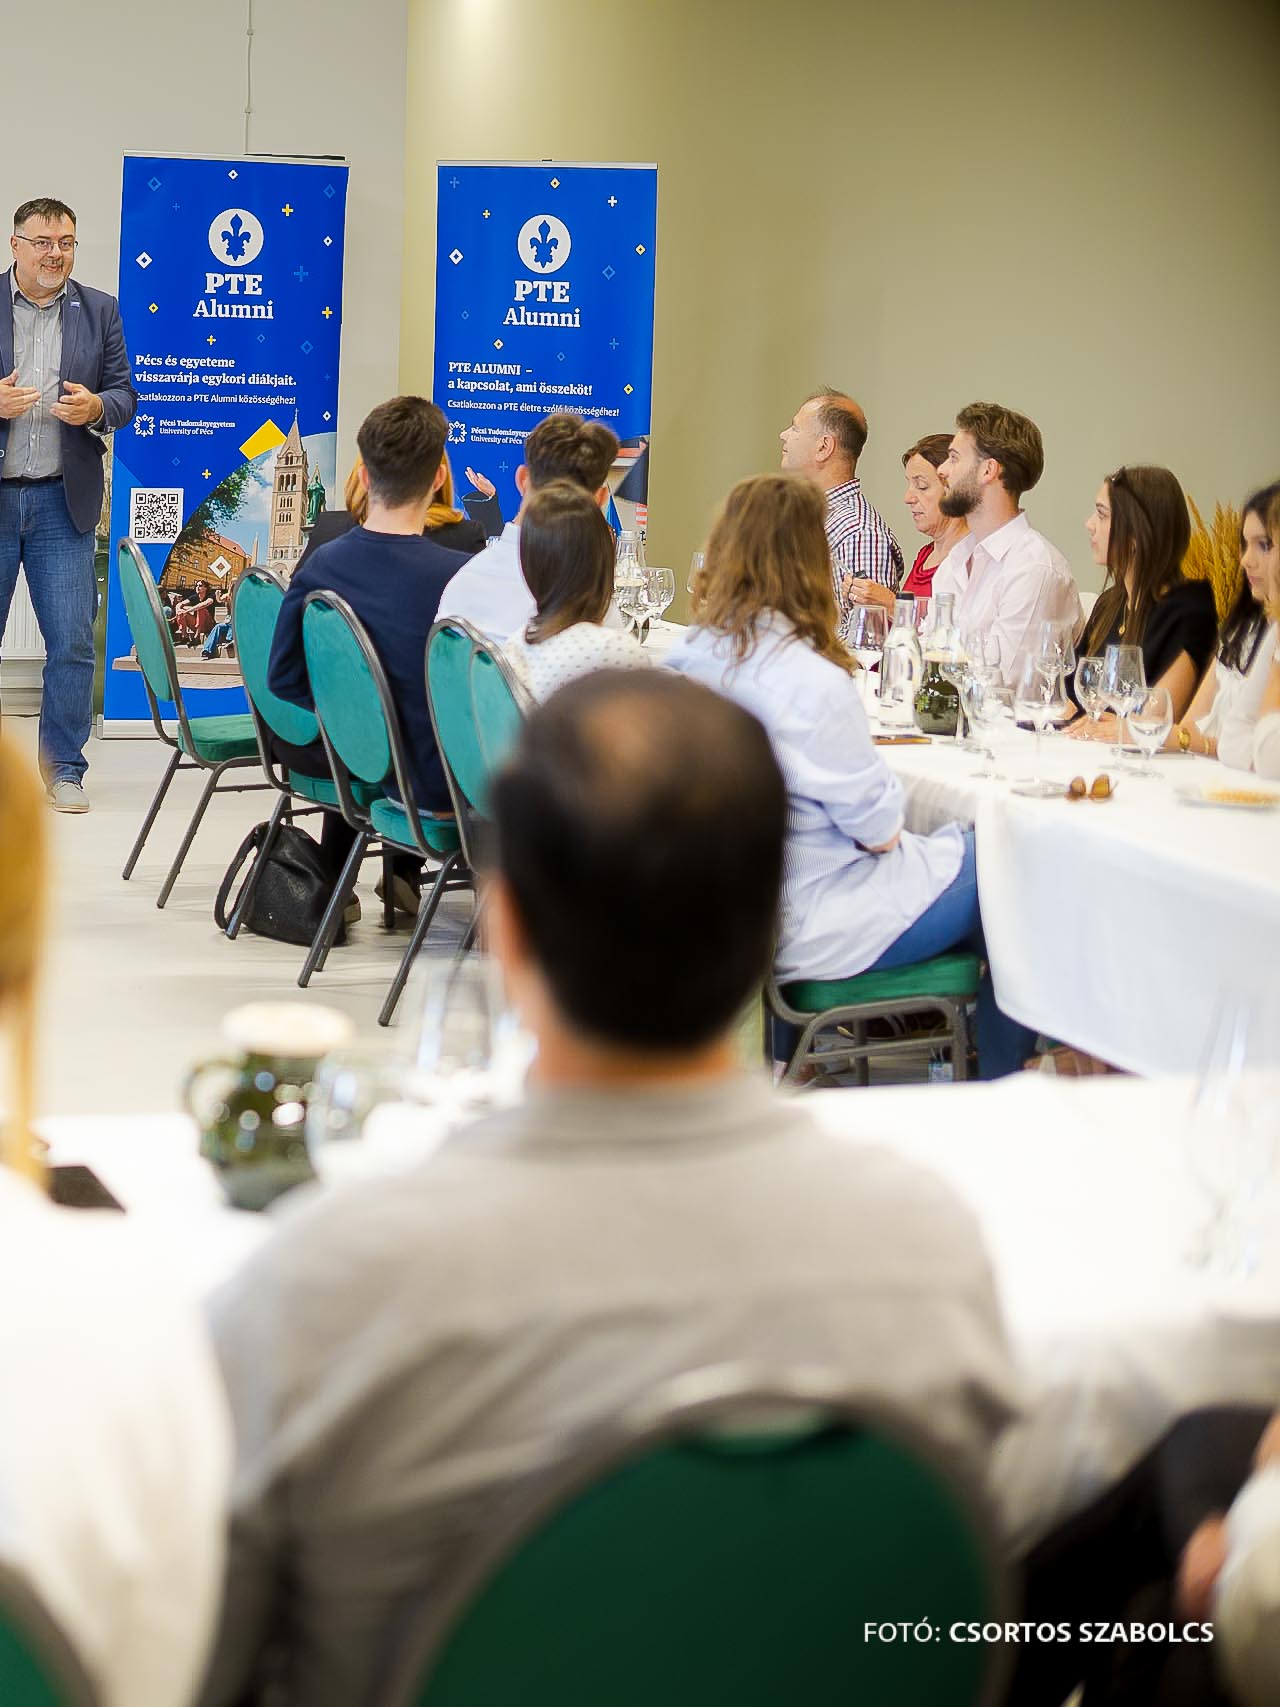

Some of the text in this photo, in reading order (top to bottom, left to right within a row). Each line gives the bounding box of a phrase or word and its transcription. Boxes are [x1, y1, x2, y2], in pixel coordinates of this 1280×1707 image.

[204, 272, 263, 295] PTE
[514, 280, 570, 303] PTE
[192, 298, 274, 319] Alumni
[502, 306, 581, 328] Alumni
[135, 354, 236, 369] Pécs és egyeteme
[448, 361, 471, 374] PTE
[473, 362, 521, 376] ALUMNI
[135, 371, 297, 388] visszavárja egykori diákjait.
[448, 378, 592, 396] a kapcsolat, ami összeköt!
[193, 394, 209, 403] PTE
[210, 394, 238, 403] Alumni
[238, 395, 296, 406] közösségéhez!
[447, 400, 497, 411] Csatlakozzon
[503, 403, 519, 412] PTE
[519, 403, 542, 412] életre
[159, 419, 236, 429] Pécsi Tudományegyetem
[159, 427, 192, 436] University
[471, 427, 487, 435] Pécsi
[470, 435, 502, 444] University
[502, 436, 509, 444] of
